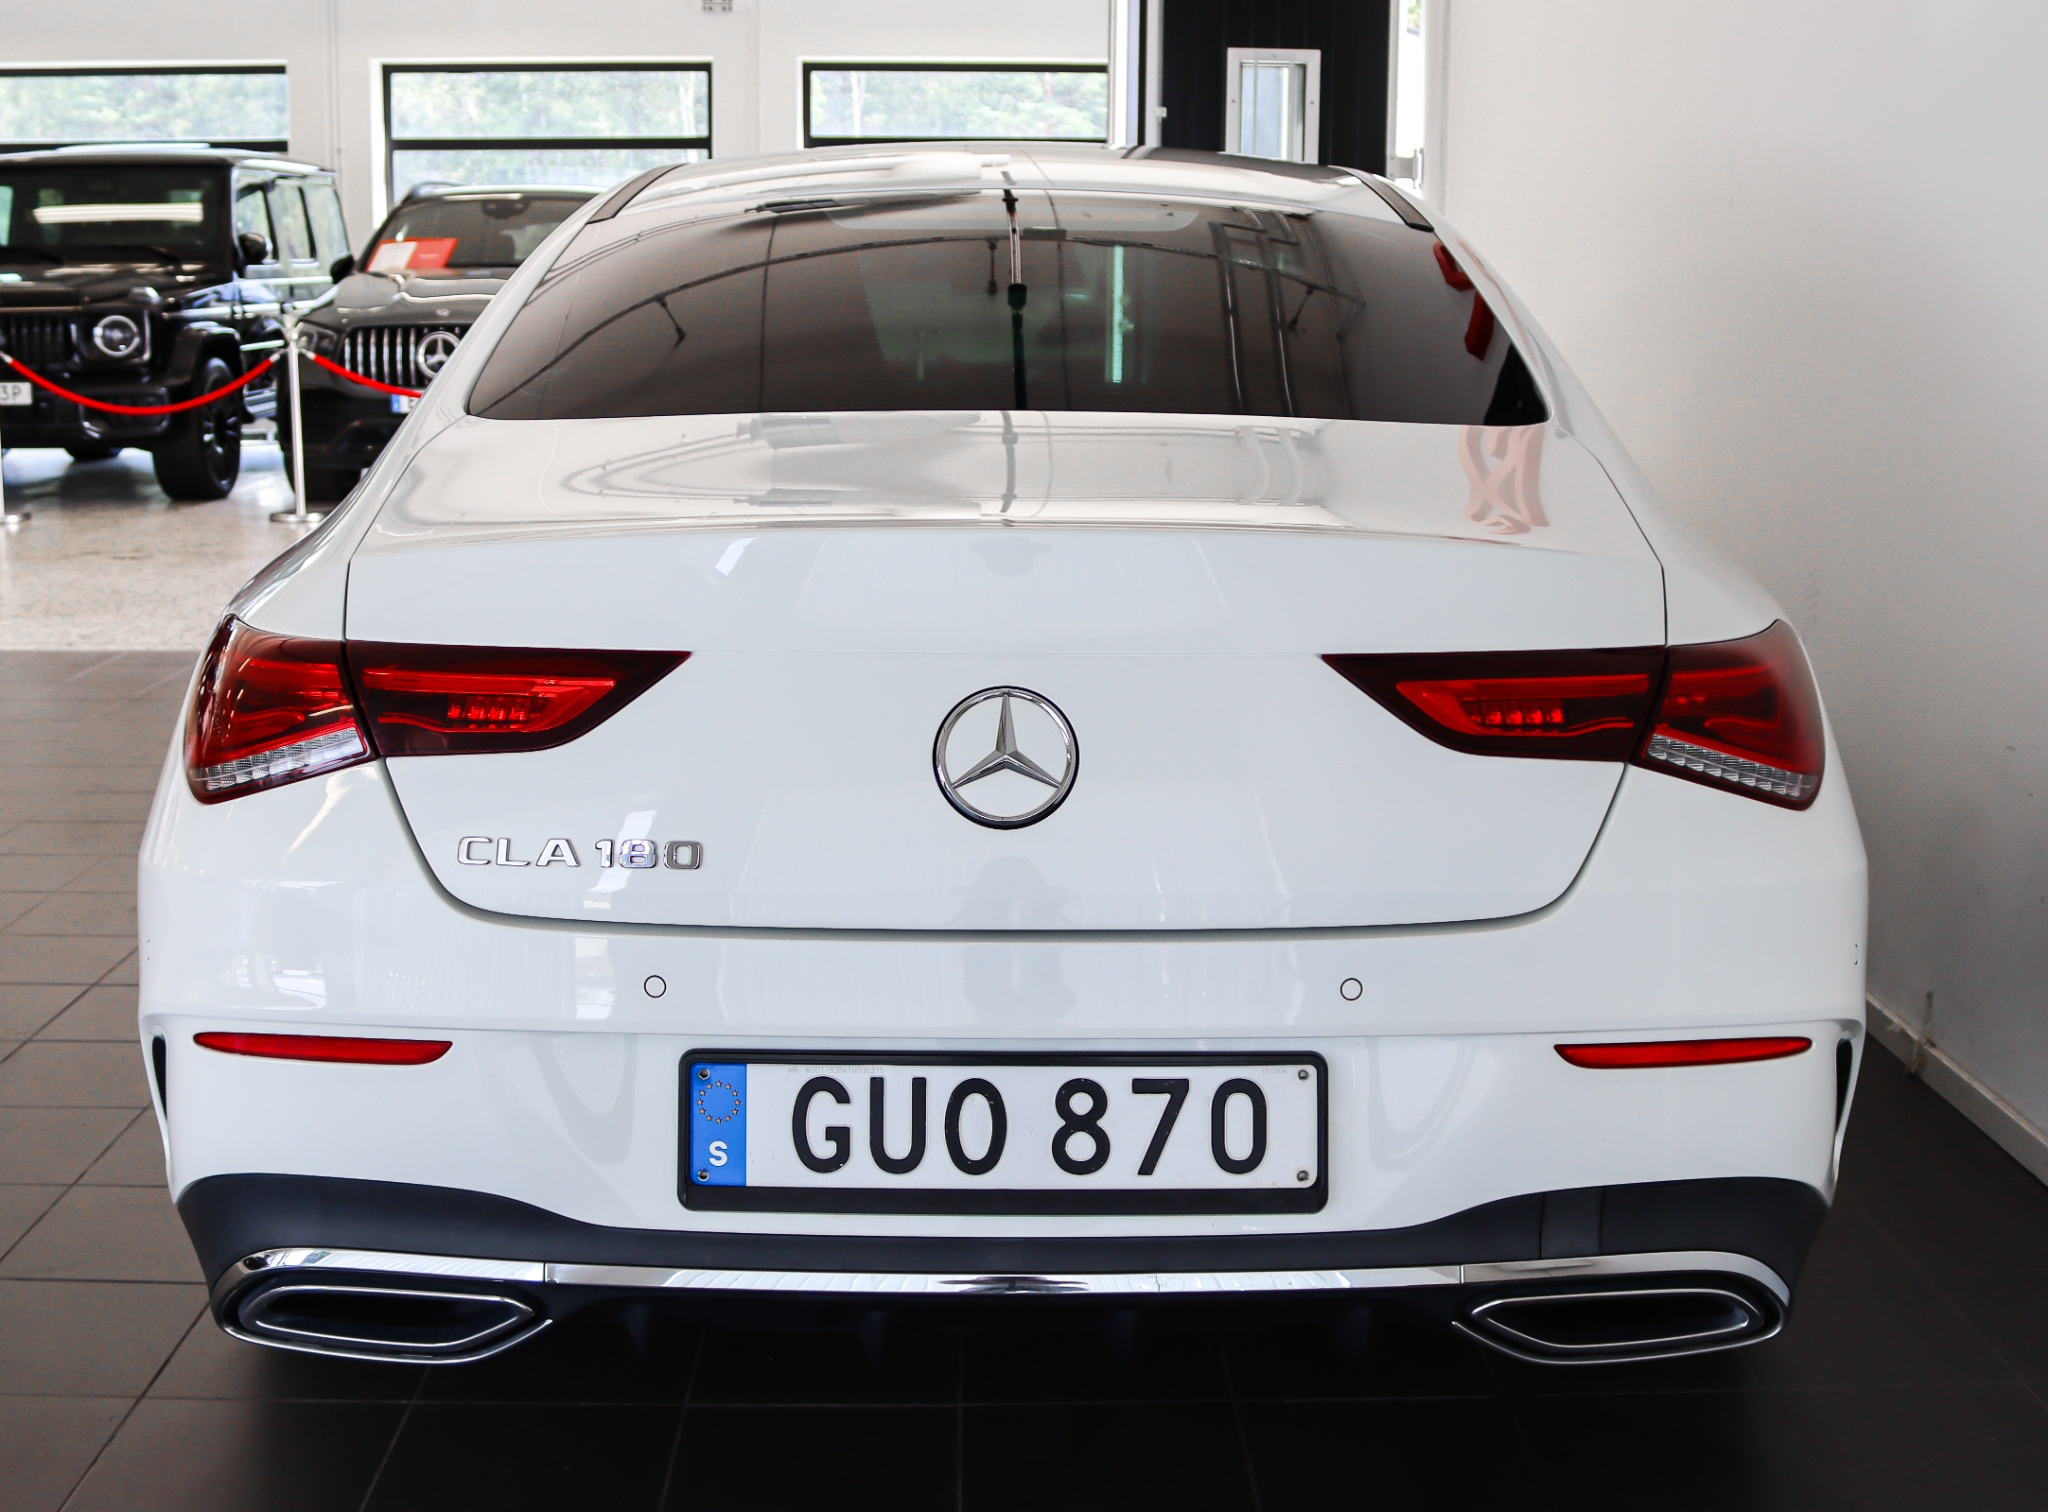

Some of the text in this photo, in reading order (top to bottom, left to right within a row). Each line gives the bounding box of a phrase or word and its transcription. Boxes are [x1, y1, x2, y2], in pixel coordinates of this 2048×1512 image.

[457, 836, 703, 869] CLA 180
[791, 1076, 1268, 1177] GUO 870
[709, 1141, 728, 1167] S
